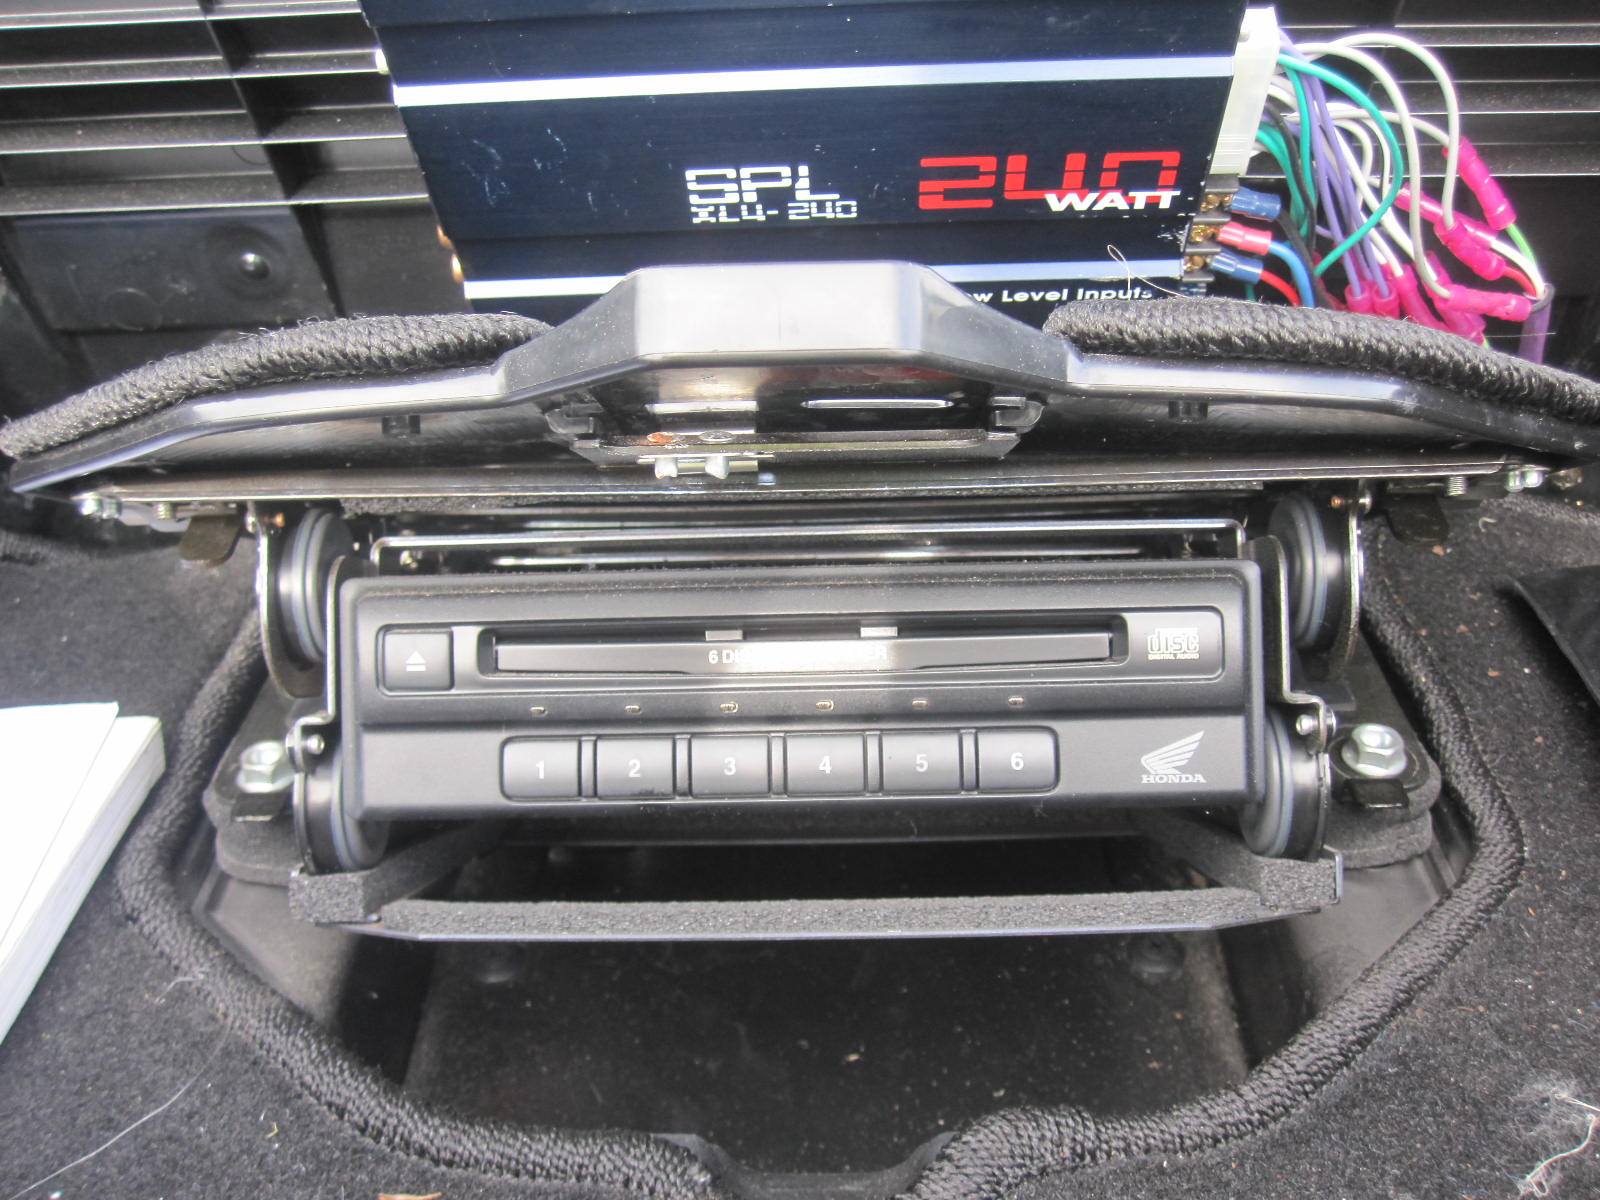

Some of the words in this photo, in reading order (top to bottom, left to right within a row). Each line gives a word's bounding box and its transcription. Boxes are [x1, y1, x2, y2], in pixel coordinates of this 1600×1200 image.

[685, 165, 840, 205] SPL
[918, 151, 1181, 211] 240
[1045, 190, 1181, 212] WATT
[1001, 288, 1068, 303] Level
[1076, 285, 1154, 302] Inputs
[708, 649, 719, 665] 6
[628, 760, 641, 778] 2
[723, 758, 737, 776] 3
[818, 755, 832, 774] 4
[915, 754, 929, 772] 5
[1010, 752, 1024, 770] 6
[535, 761, 546, 780] 1
[1140, 773, 1207, 784] HONDA
